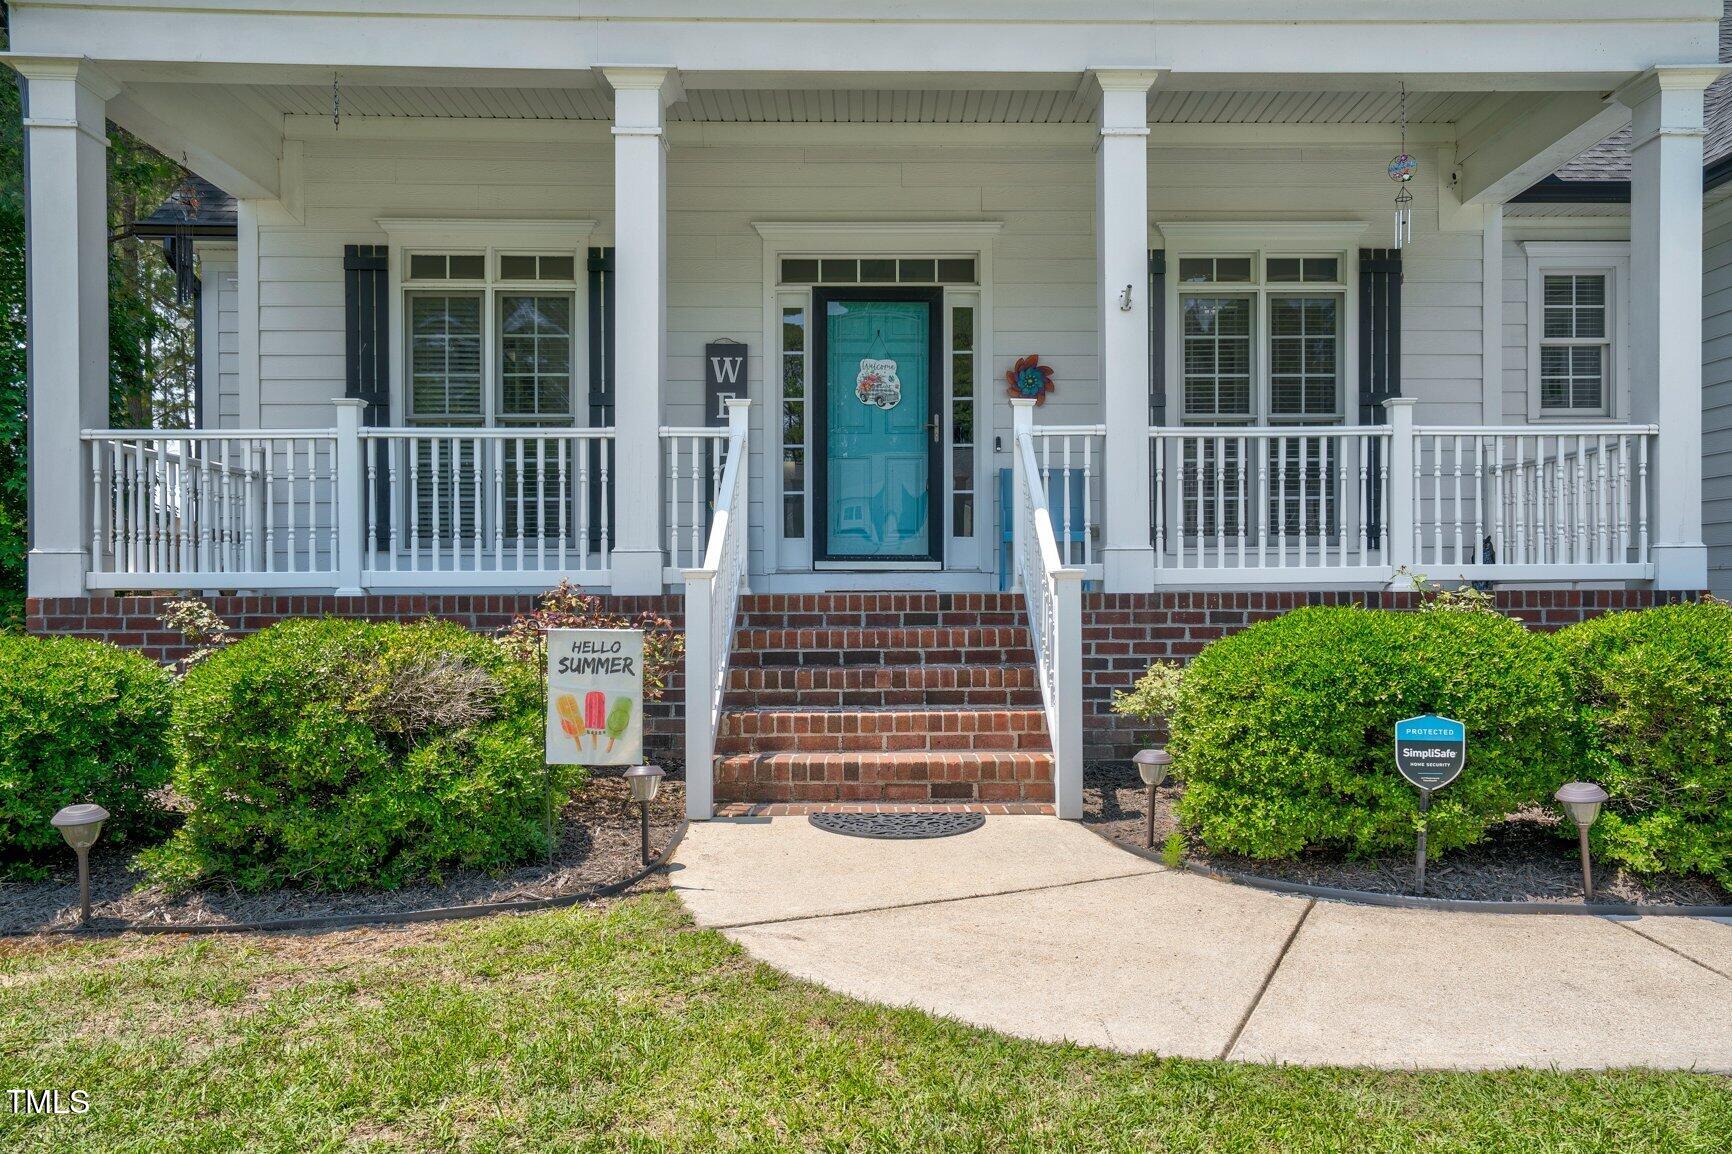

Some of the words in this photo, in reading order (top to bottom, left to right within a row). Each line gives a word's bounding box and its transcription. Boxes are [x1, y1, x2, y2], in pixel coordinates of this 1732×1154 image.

[572, 640, 622, 654] HELLO
[558, 656, 636, 676] SUMMER
[1406, 728, 1454, 736] PROTECTED
[1403, 748, 1456, 759] SimpliSafe
